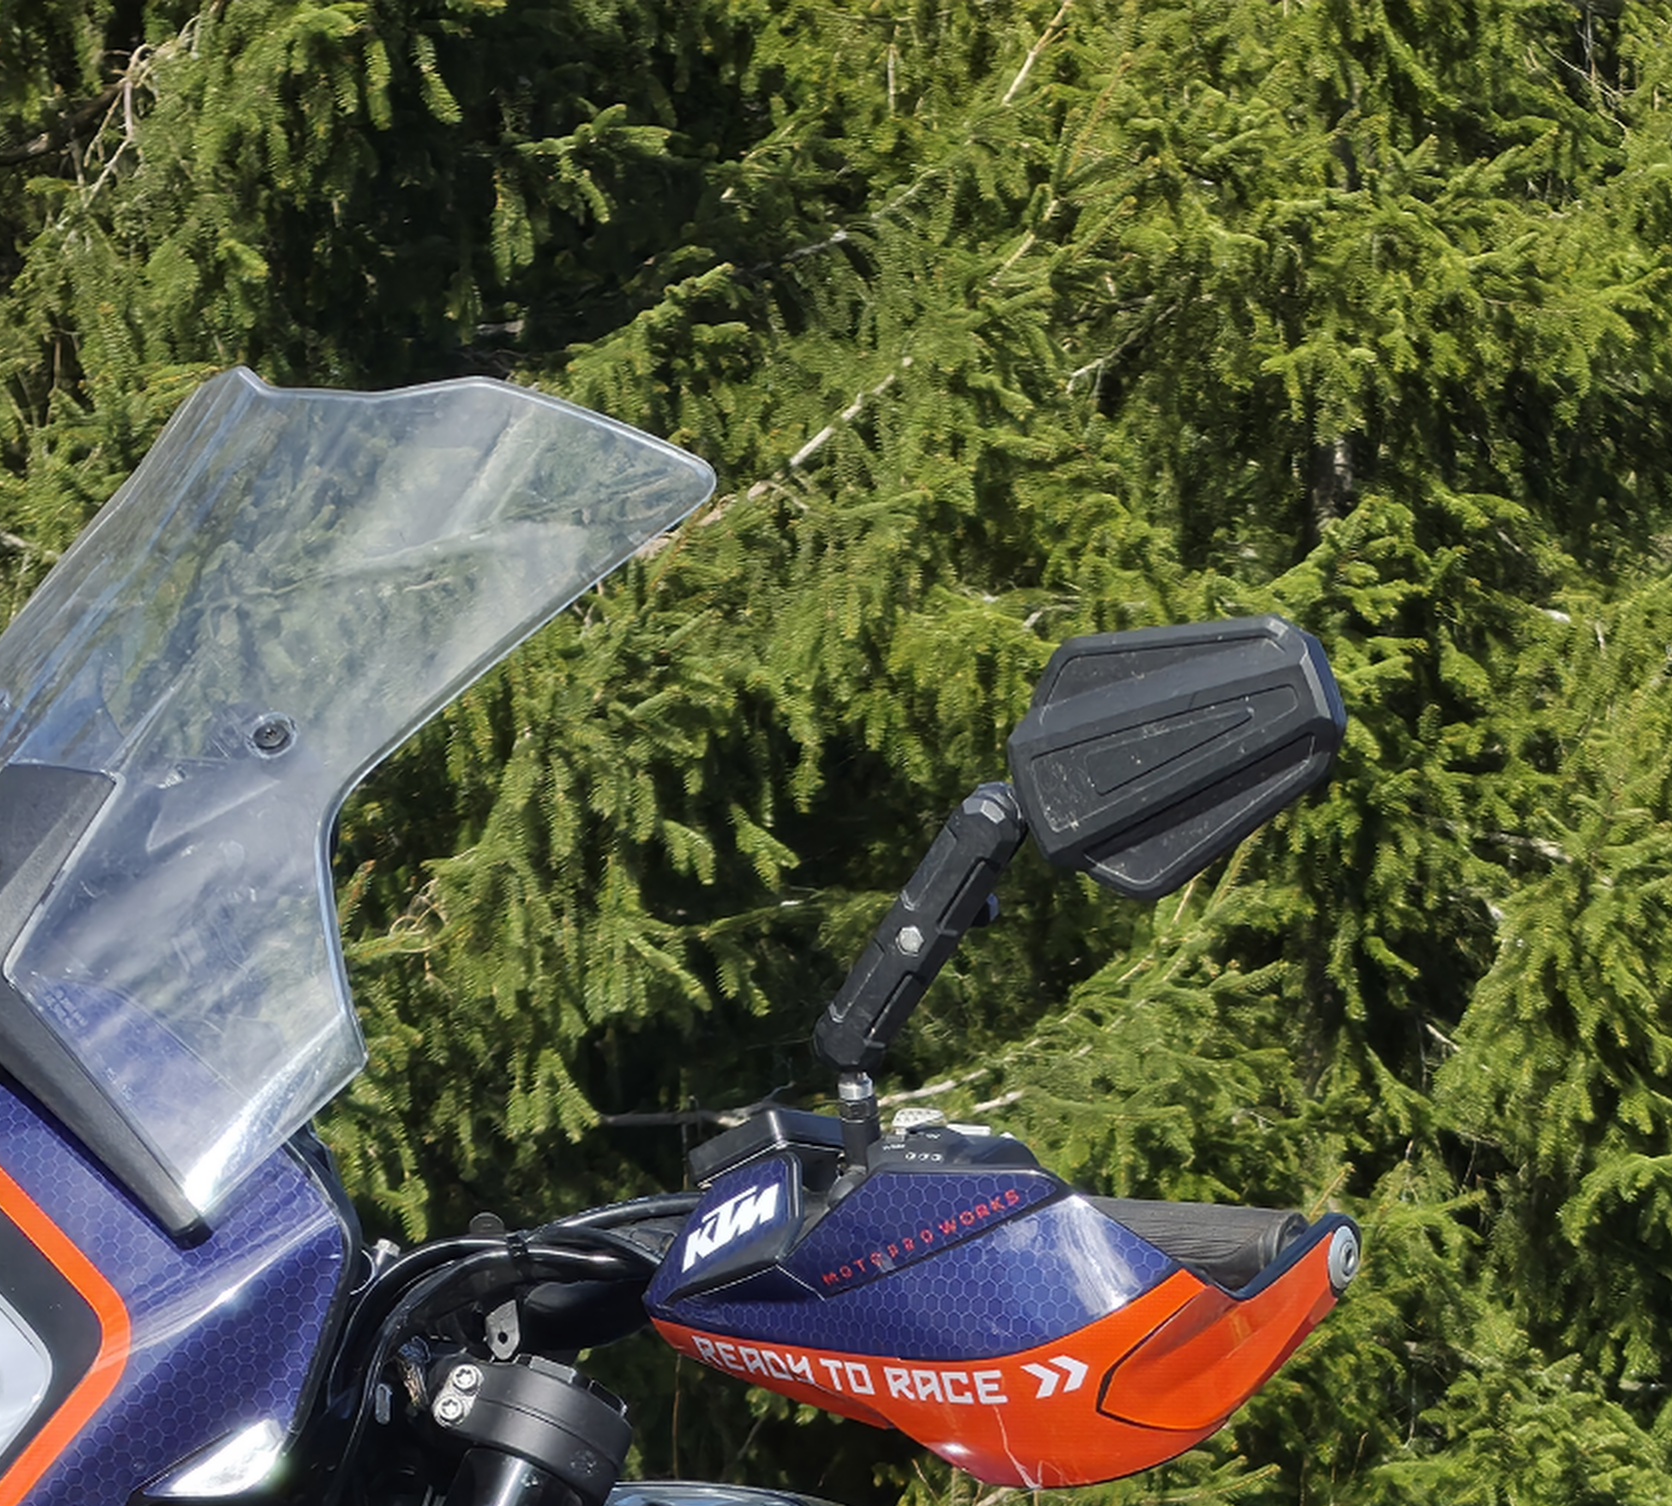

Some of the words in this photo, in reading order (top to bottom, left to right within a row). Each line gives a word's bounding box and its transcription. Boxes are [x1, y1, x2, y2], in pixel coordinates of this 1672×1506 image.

[682, 1182, 780, 1272] KTM
[690, 1334, 817, 1386] READY
[818, 1356, 873, 1396] TO
[884, 1366, 1009, 1405] RACE
